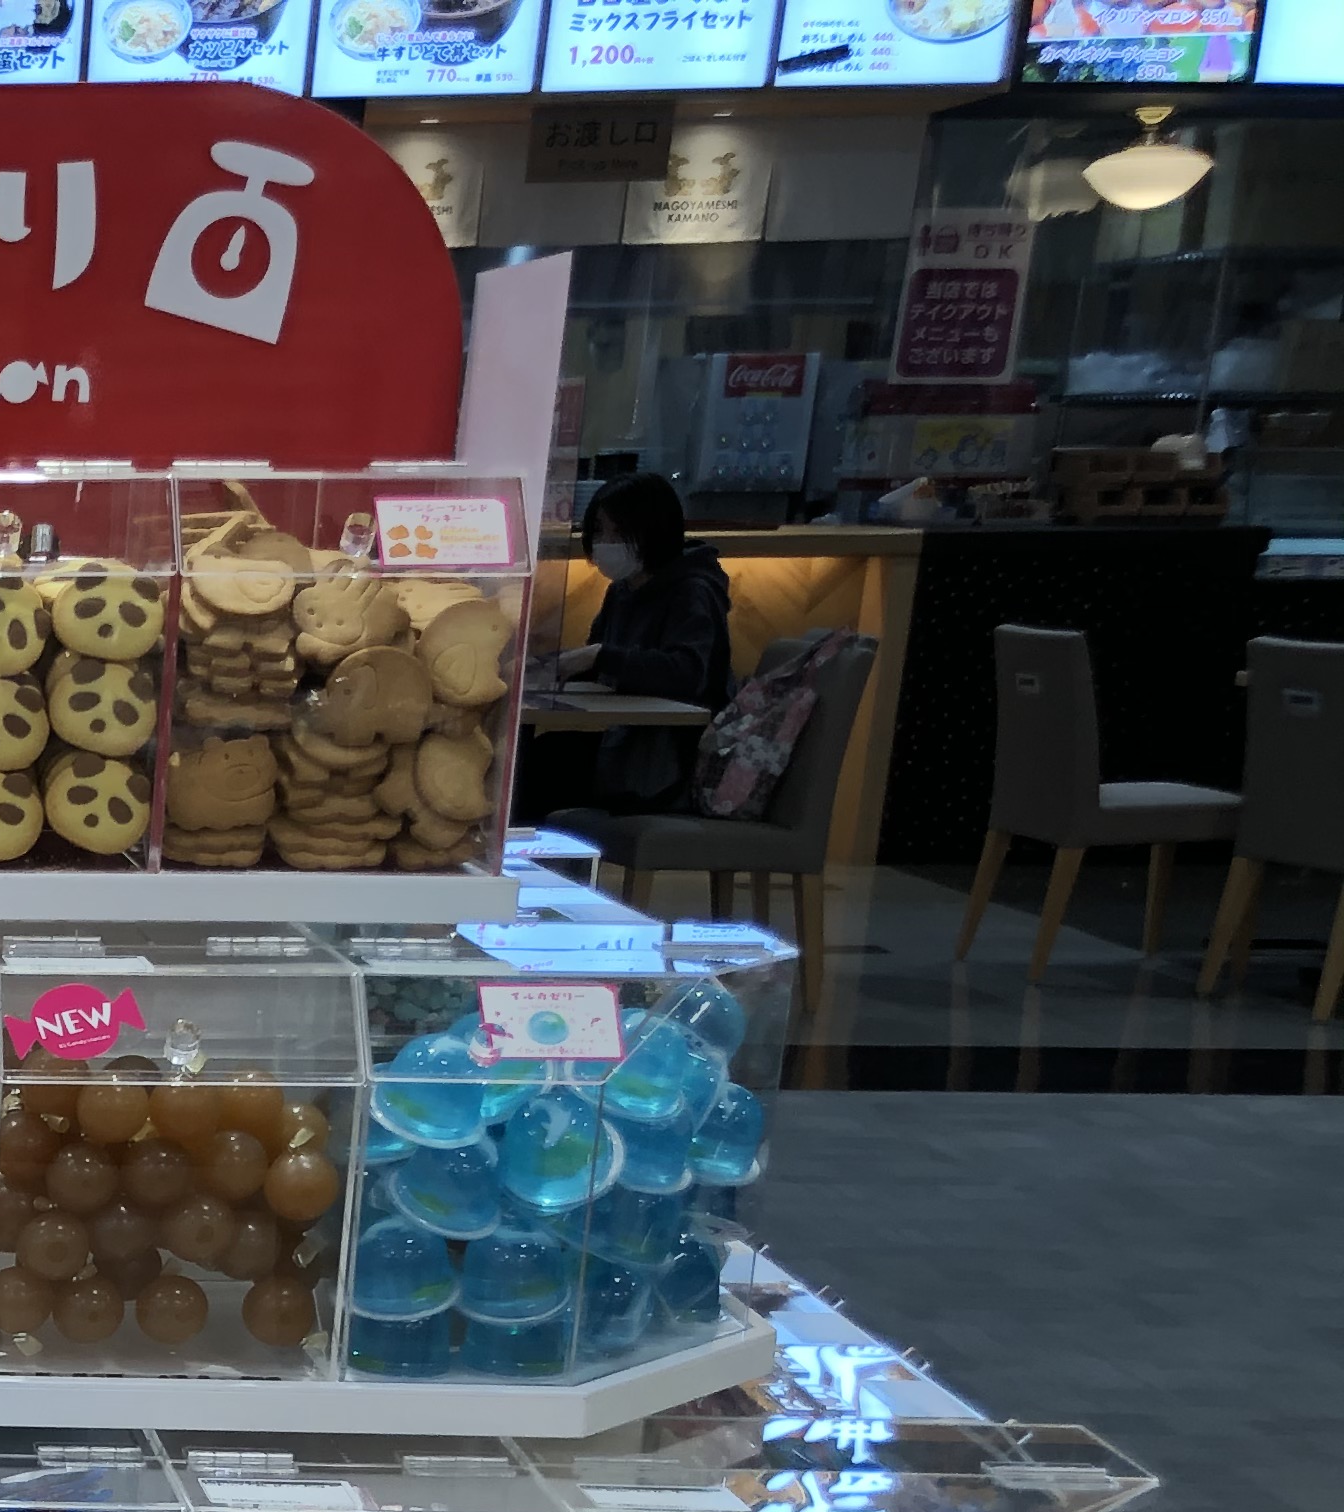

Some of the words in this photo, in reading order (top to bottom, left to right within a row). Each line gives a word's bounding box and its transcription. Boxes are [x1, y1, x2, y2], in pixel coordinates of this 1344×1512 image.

[569, 9, 753, 32] ミックスフライセット
[569, 44, 635, 68] 1,200
[426, 68, 457, 83] 770
[544, 121, 659, 149] お渡し口
[652, 199, 738, 213] NAGOYAMESHI
[666, 212, 720, 224] KAMANO
[924, 280, 998, 300] 当店では
[910, 304, 1008, 321] テイクアウト
[911, 325, 999, 343] メニューも
[908, 347, 996, 365] ございます
[34, 1001, 112, 1040] NEW
